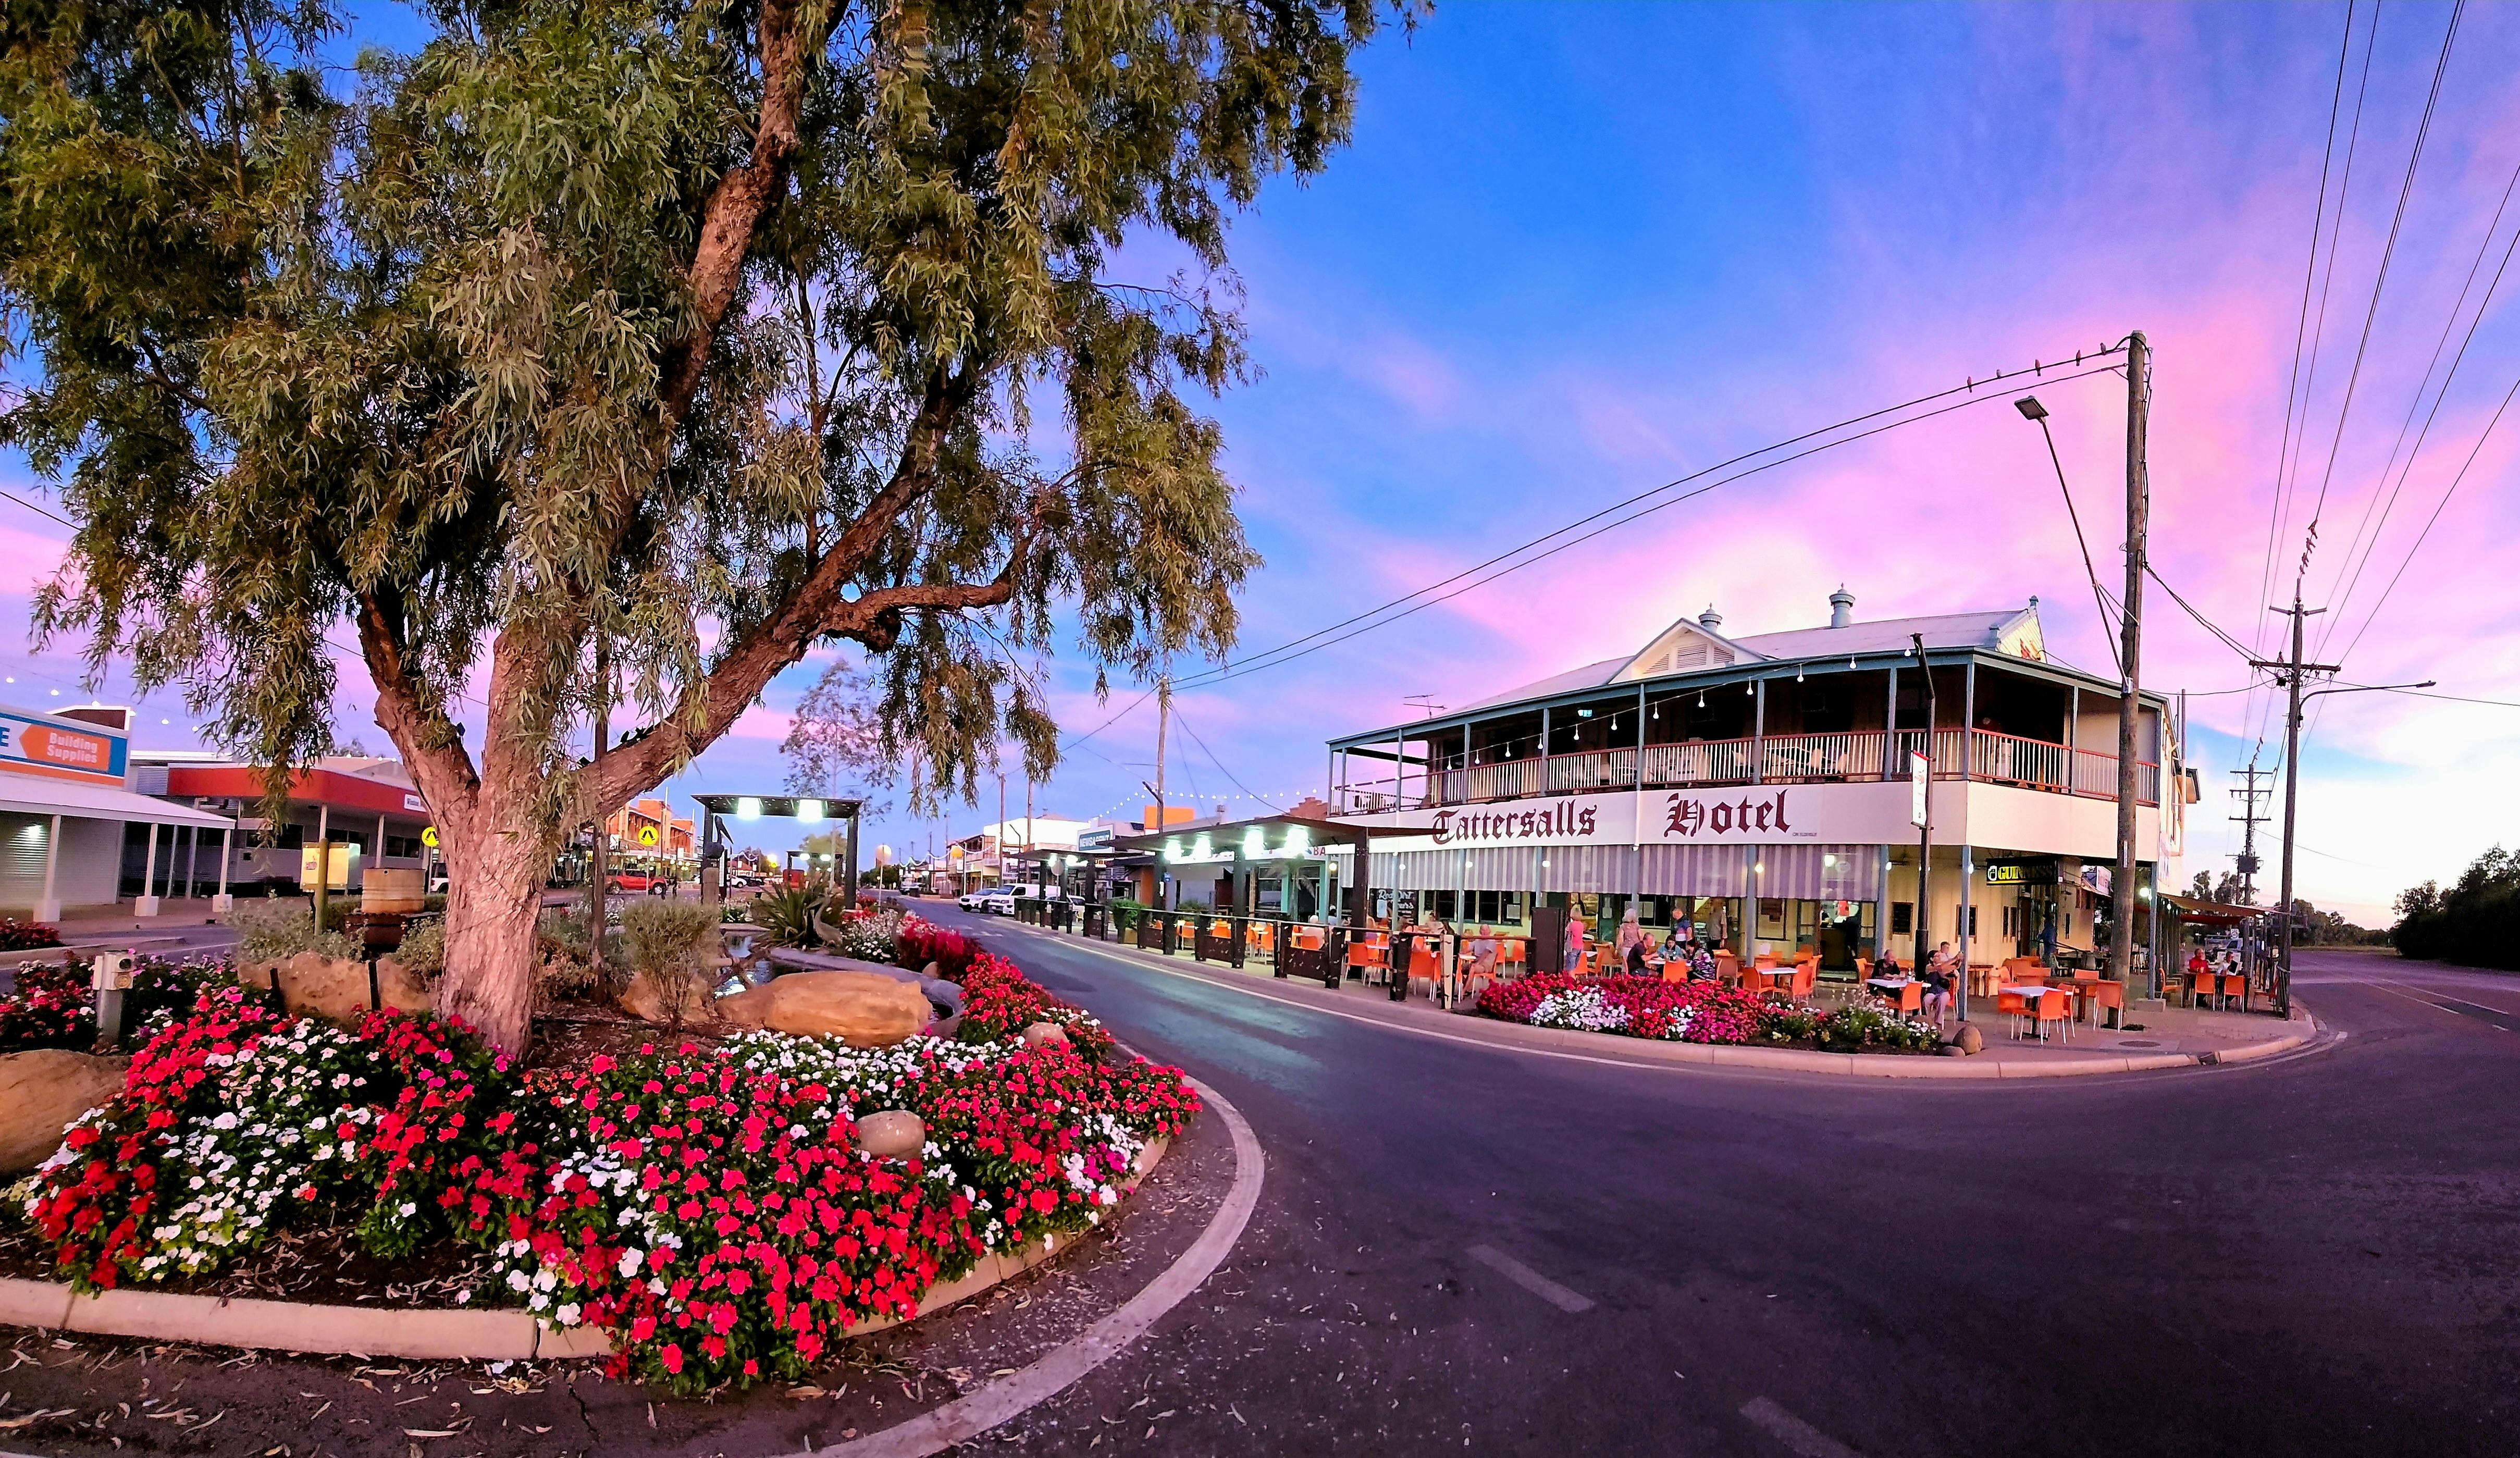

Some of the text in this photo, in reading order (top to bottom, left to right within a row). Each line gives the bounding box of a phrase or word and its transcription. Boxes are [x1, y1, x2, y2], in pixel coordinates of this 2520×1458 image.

[47, 745, 97, 763] Supplies
[50, 732, 98, 753] Building
[1432, 798, 1597, 845] Tattersalls
[1663, 788, 1791, 838] Hotel
